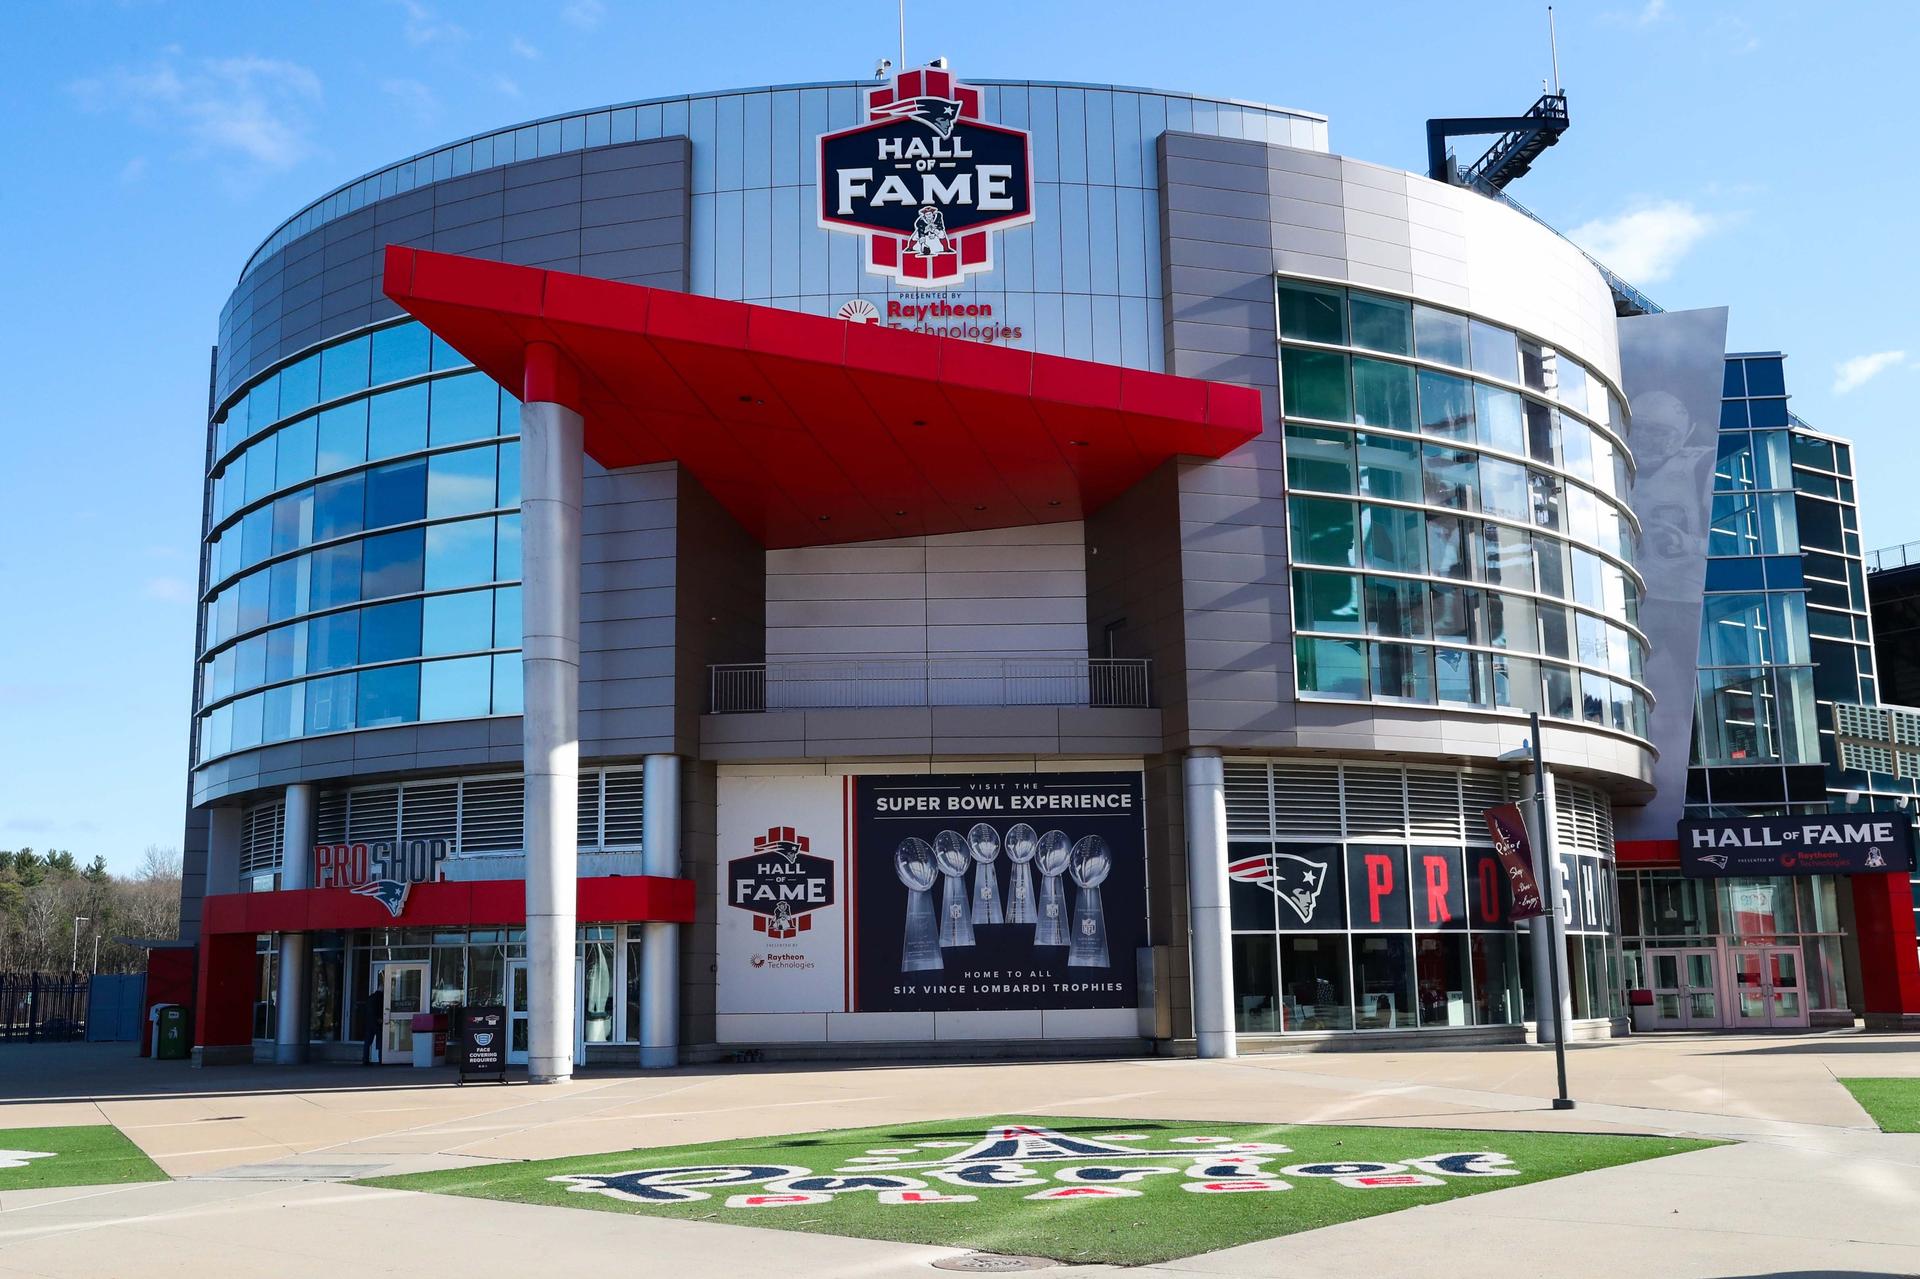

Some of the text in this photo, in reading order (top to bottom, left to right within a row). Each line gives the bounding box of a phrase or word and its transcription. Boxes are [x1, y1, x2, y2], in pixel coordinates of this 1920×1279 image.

[878, 136, 973, 160] HALL
[915, 159, 936, 172] OF
[836, 164, 1014, 215] FAME
[887, 299, 992, 321] Raytheon
[887, 321, 1023, 343] Tchnologies
[876, 793, 1132, 812] SUPER BOWL EXPERIENCE
[1691, 822, 1895, 848] HALL OF FAME
[313, 838, 448, 889] PRO SHOP
[757, 863, 806, 875] HALL
[736, 878, 826, 904] FAME
[1363, 854, 1617, 928] PRO SHO
[767, 953, 805, 962] Raytheon
[767, 961, 815, 970] Technologies
[964, 970, 1053, 979] HOME TO ALL
[893, 982, 1124, 995] SIX VINCE LOMBARDI TROPHIES
[550, 1152, 1518, 1203] Patriot
[735, 1175, 1432, 1207] PLACE
